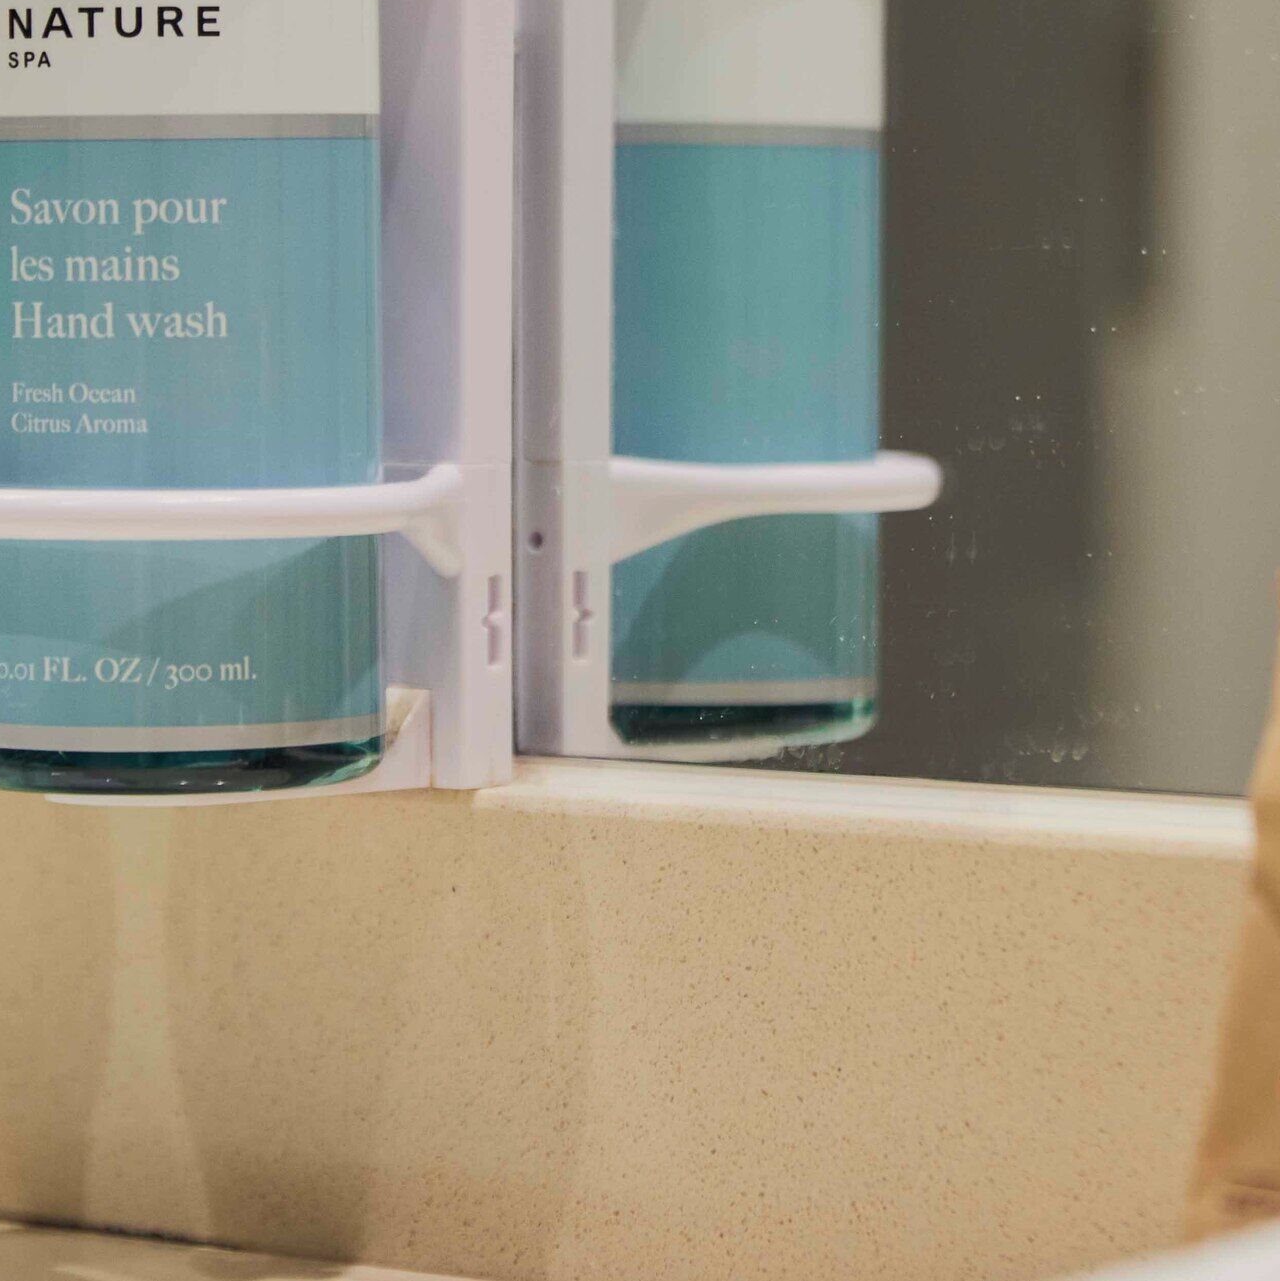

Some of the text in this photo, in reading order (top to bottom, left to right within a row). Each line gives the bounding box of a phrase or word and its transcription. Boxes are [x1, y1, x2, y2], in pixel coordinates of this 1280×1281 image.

[8, 6, 220, 39] NATURE
[8, 51, 52, 69] SPA
[10, 187, 228, 236] Savon pour
[10, 245, 181, 282] les mains
[12, 300, 229, 339] Hand wash
[12, 382, 137, 404] Fresh Ocean
[11, 412, 149, 434] Citrus Aroma
[41, 656, 88, 683] FL.
[164, 662, 213, 690] 300
[219, 655, 258, 682] ml.
